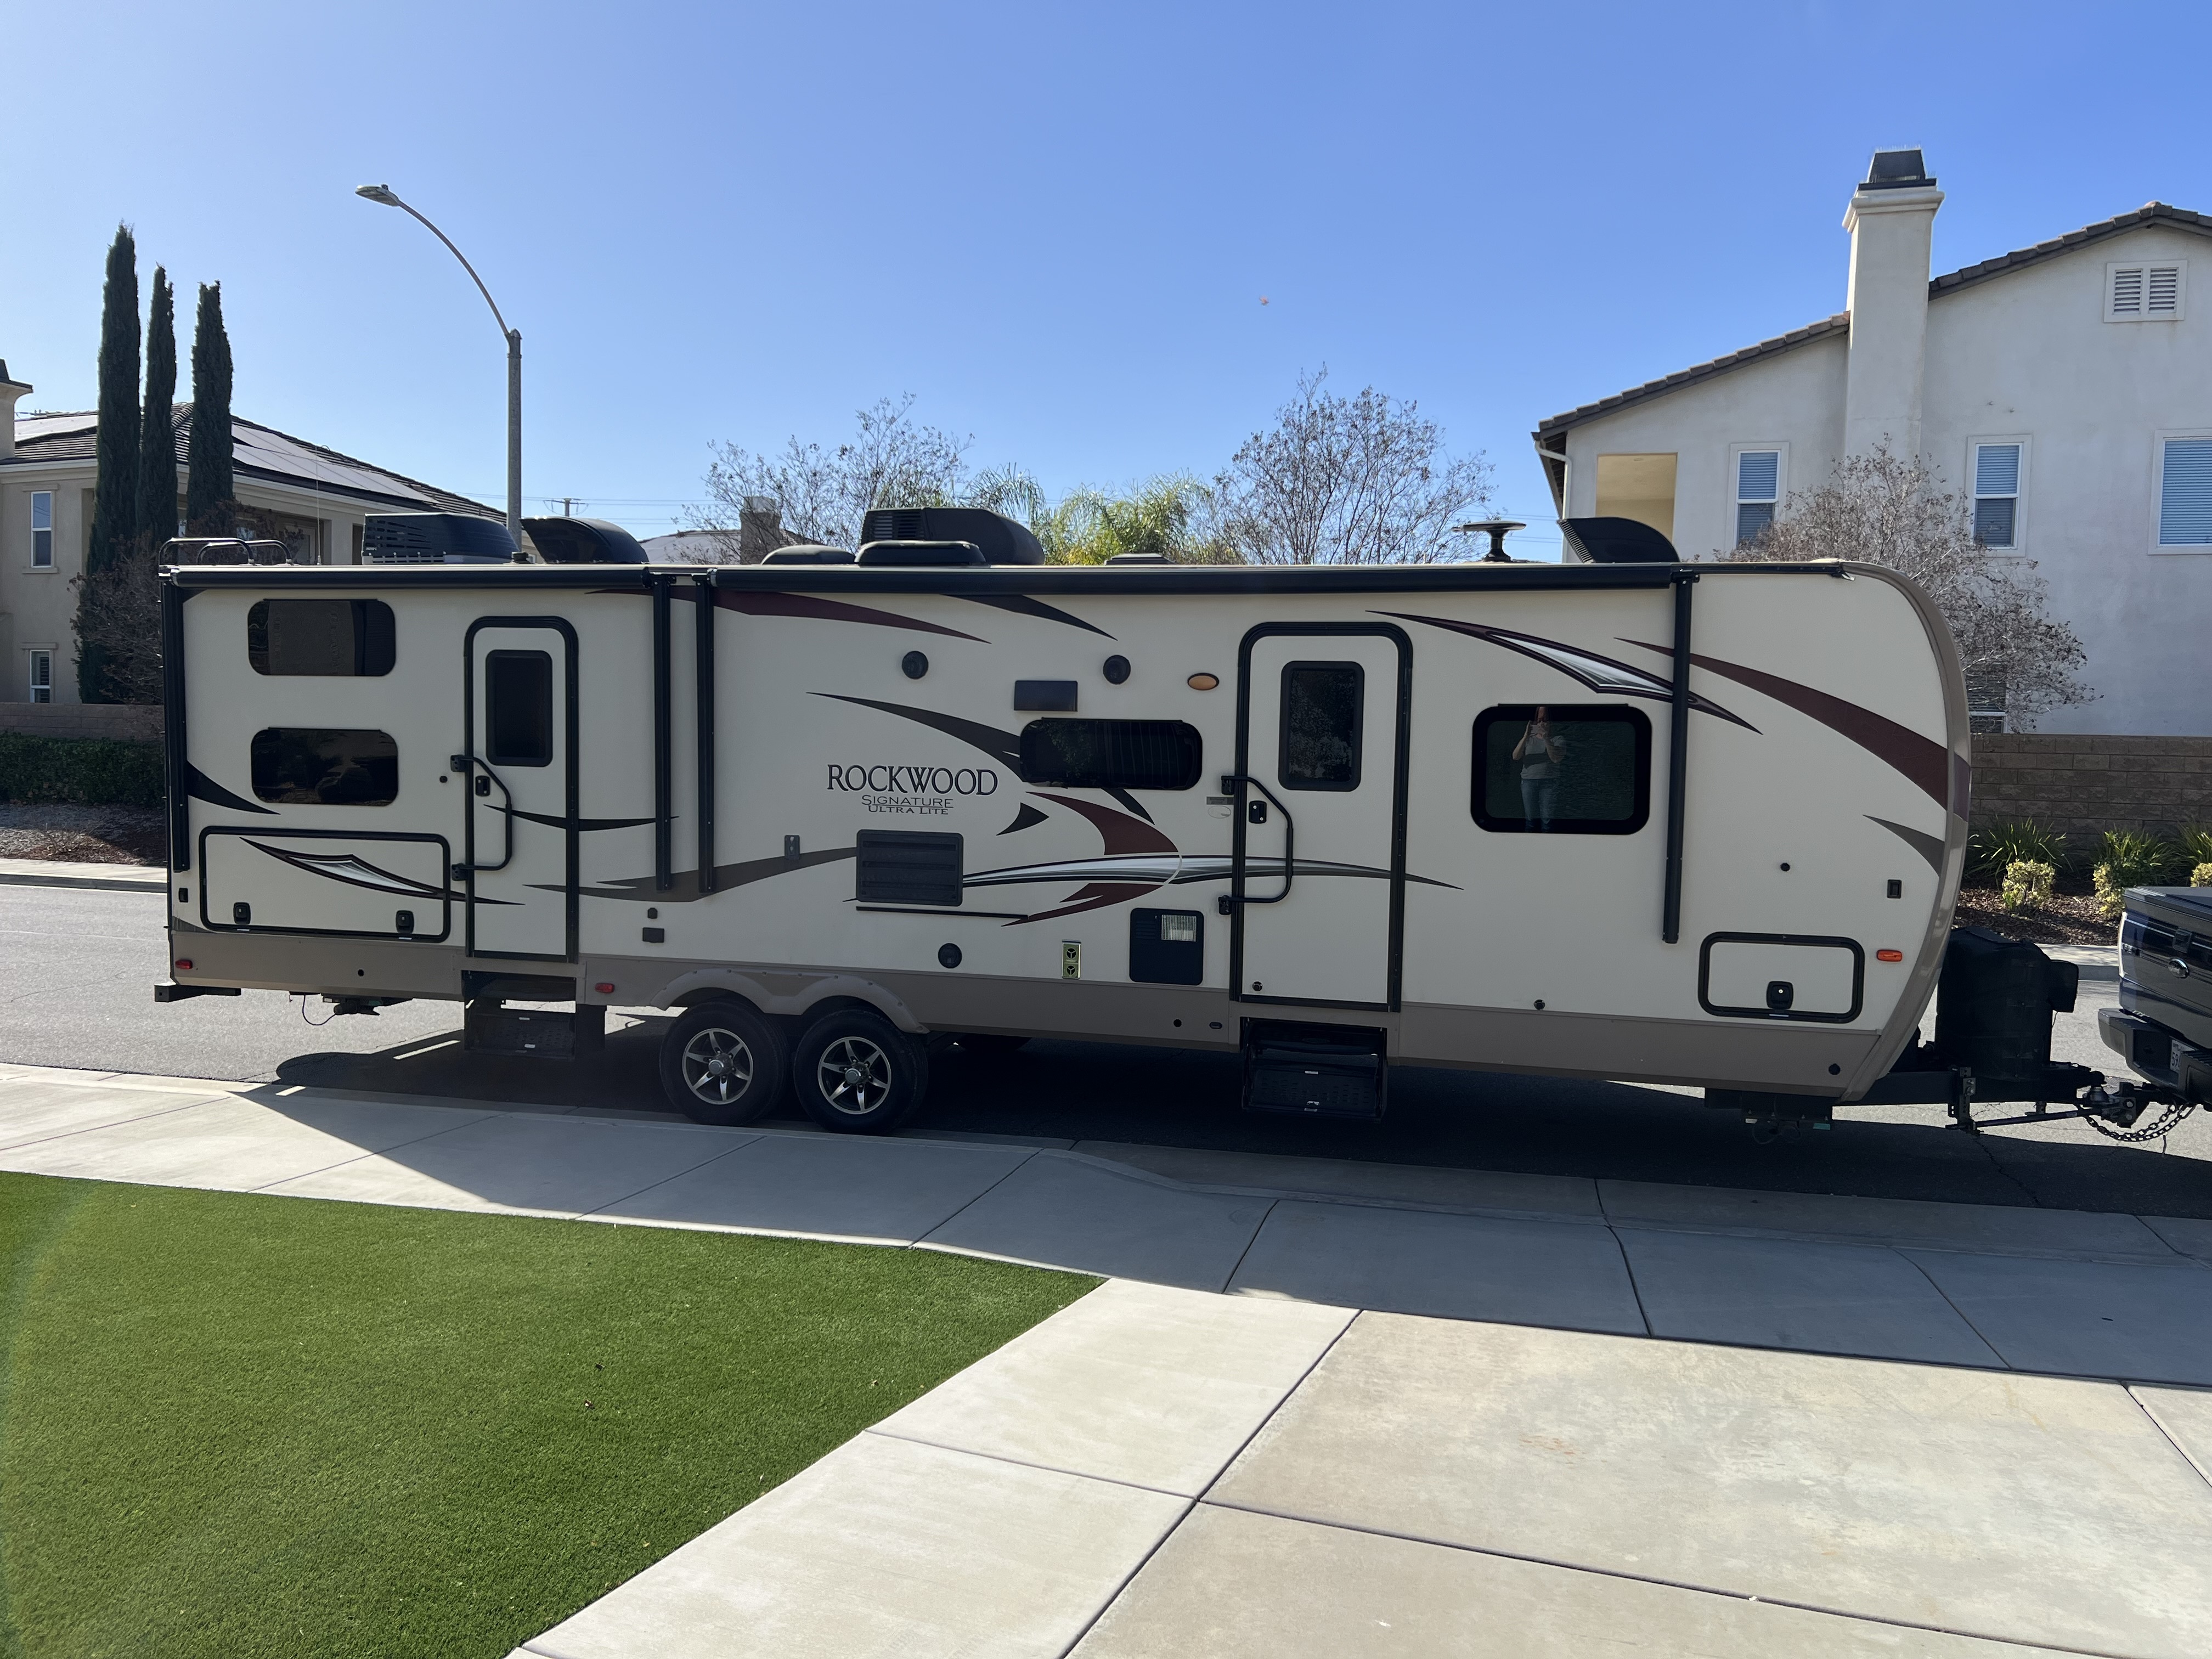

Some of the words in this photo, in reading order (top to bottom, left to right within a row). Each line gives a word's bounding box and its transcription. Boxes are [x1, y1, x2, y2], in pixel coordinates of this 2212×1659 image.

[827, 764, 998, 796] ROCKWOOD
[861, 794, 954, 809] SIGNATURE
[868, 805, 915, 814] ULTRA
[919, 807, 949, 815] LITE
